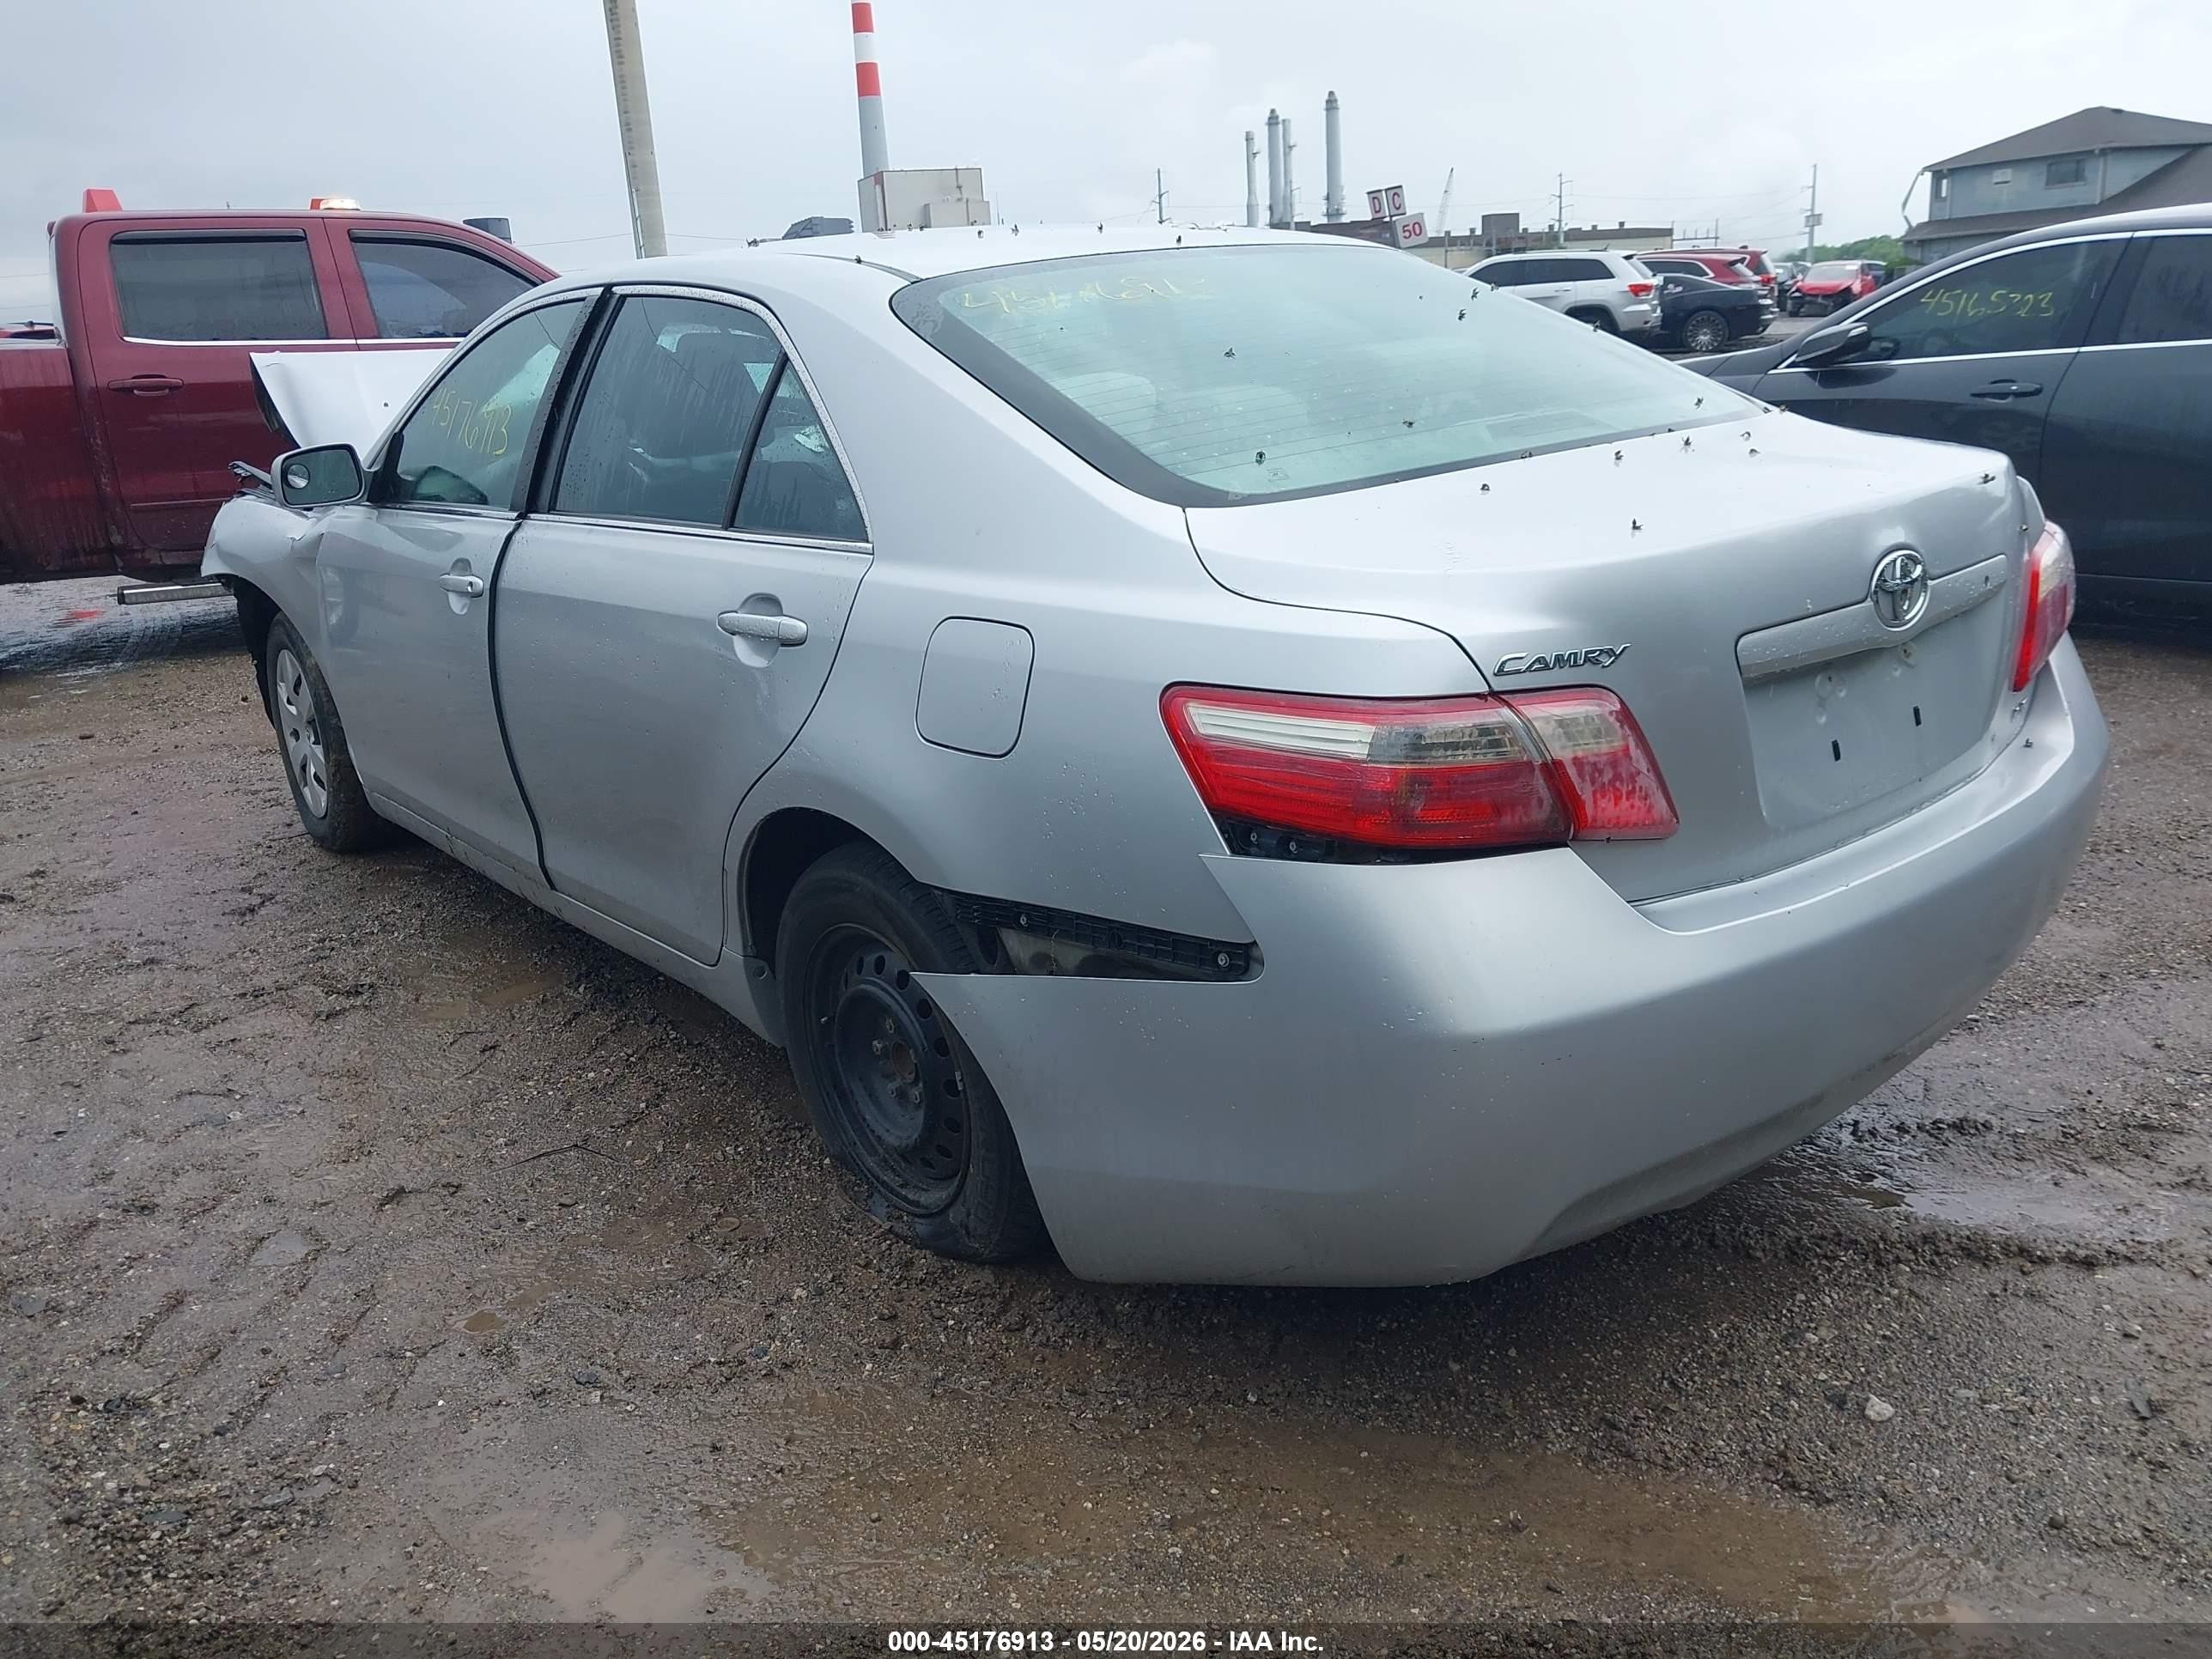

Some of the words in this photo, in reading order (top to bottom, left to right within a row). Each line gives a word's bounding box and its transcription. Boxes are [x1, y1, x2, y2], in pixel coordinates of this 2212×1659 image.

[1371, 197, 1382, 214] D
[1392, 191, 1402, 210] C
[1401, 221, 1423, 240] 50
[1492, 642, 1632, 677] CAMRY
